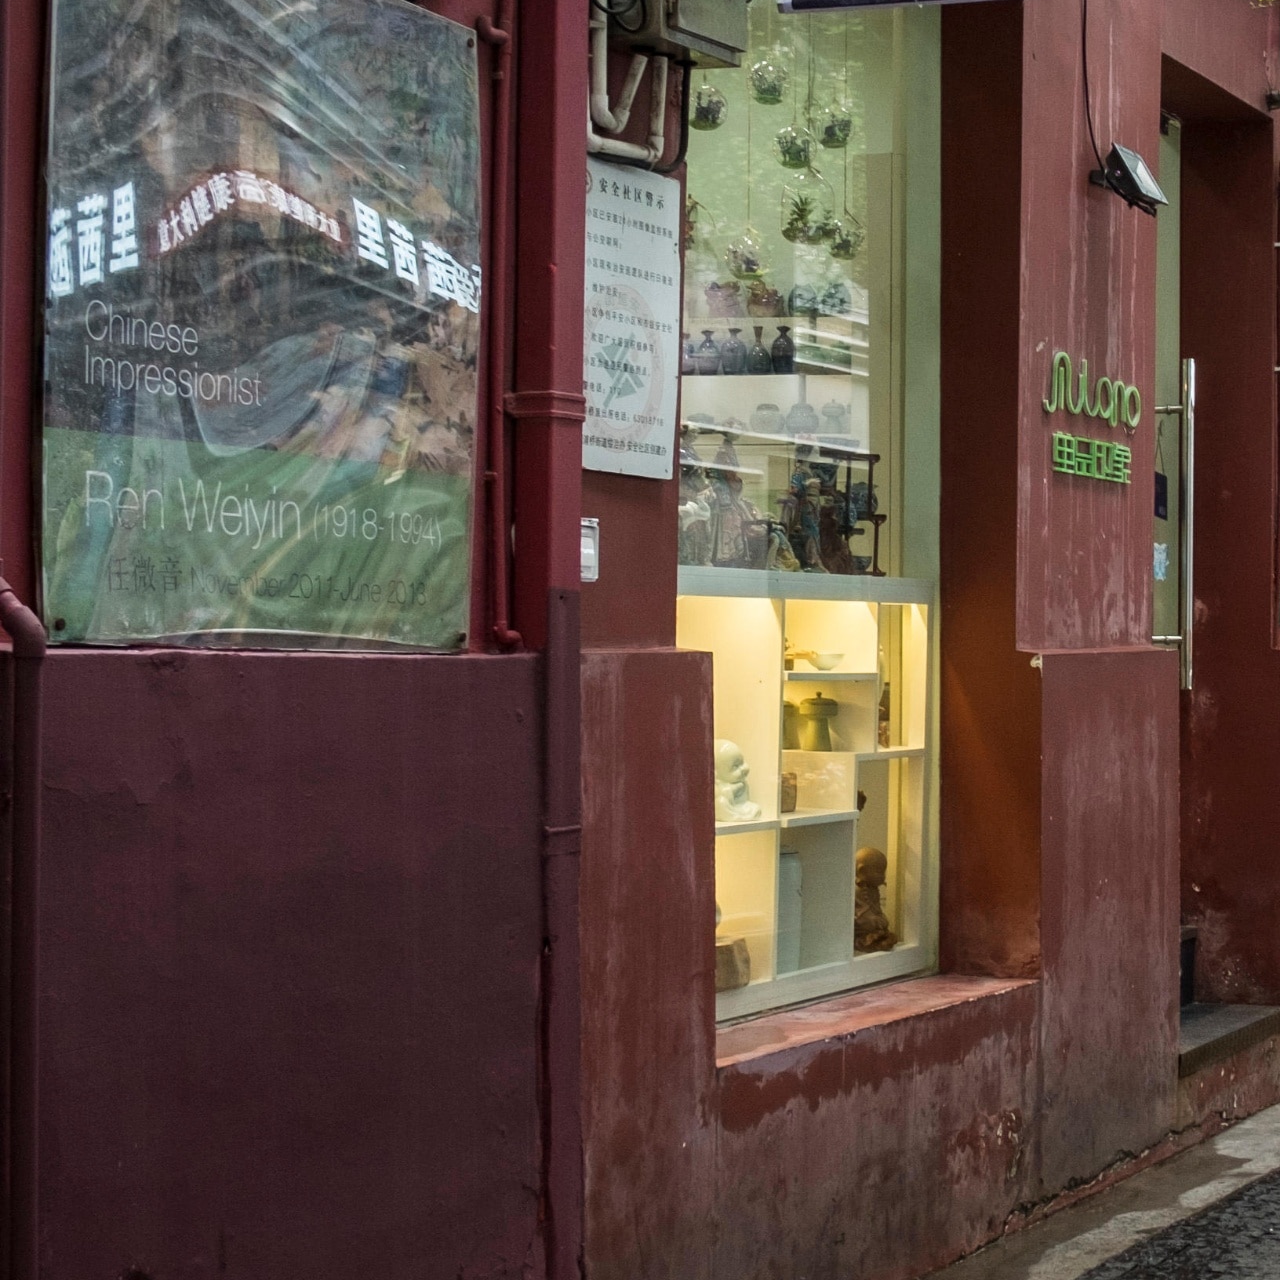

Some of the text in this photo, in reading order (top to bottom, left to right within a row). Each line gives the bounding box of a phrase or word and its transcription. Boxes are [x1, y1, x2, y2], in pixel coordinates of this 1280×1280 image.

[599, 177, 666, 211] 安全社区警示
[84, 300, 199, 357] Chinese
[83, 344, 263, 408] Impressionist
[84, 469, 443, 554] Ren Weiyin (1918-1994)
[190, 566, 287, 600] November
[289, 573, 382, 605] 2011-June
